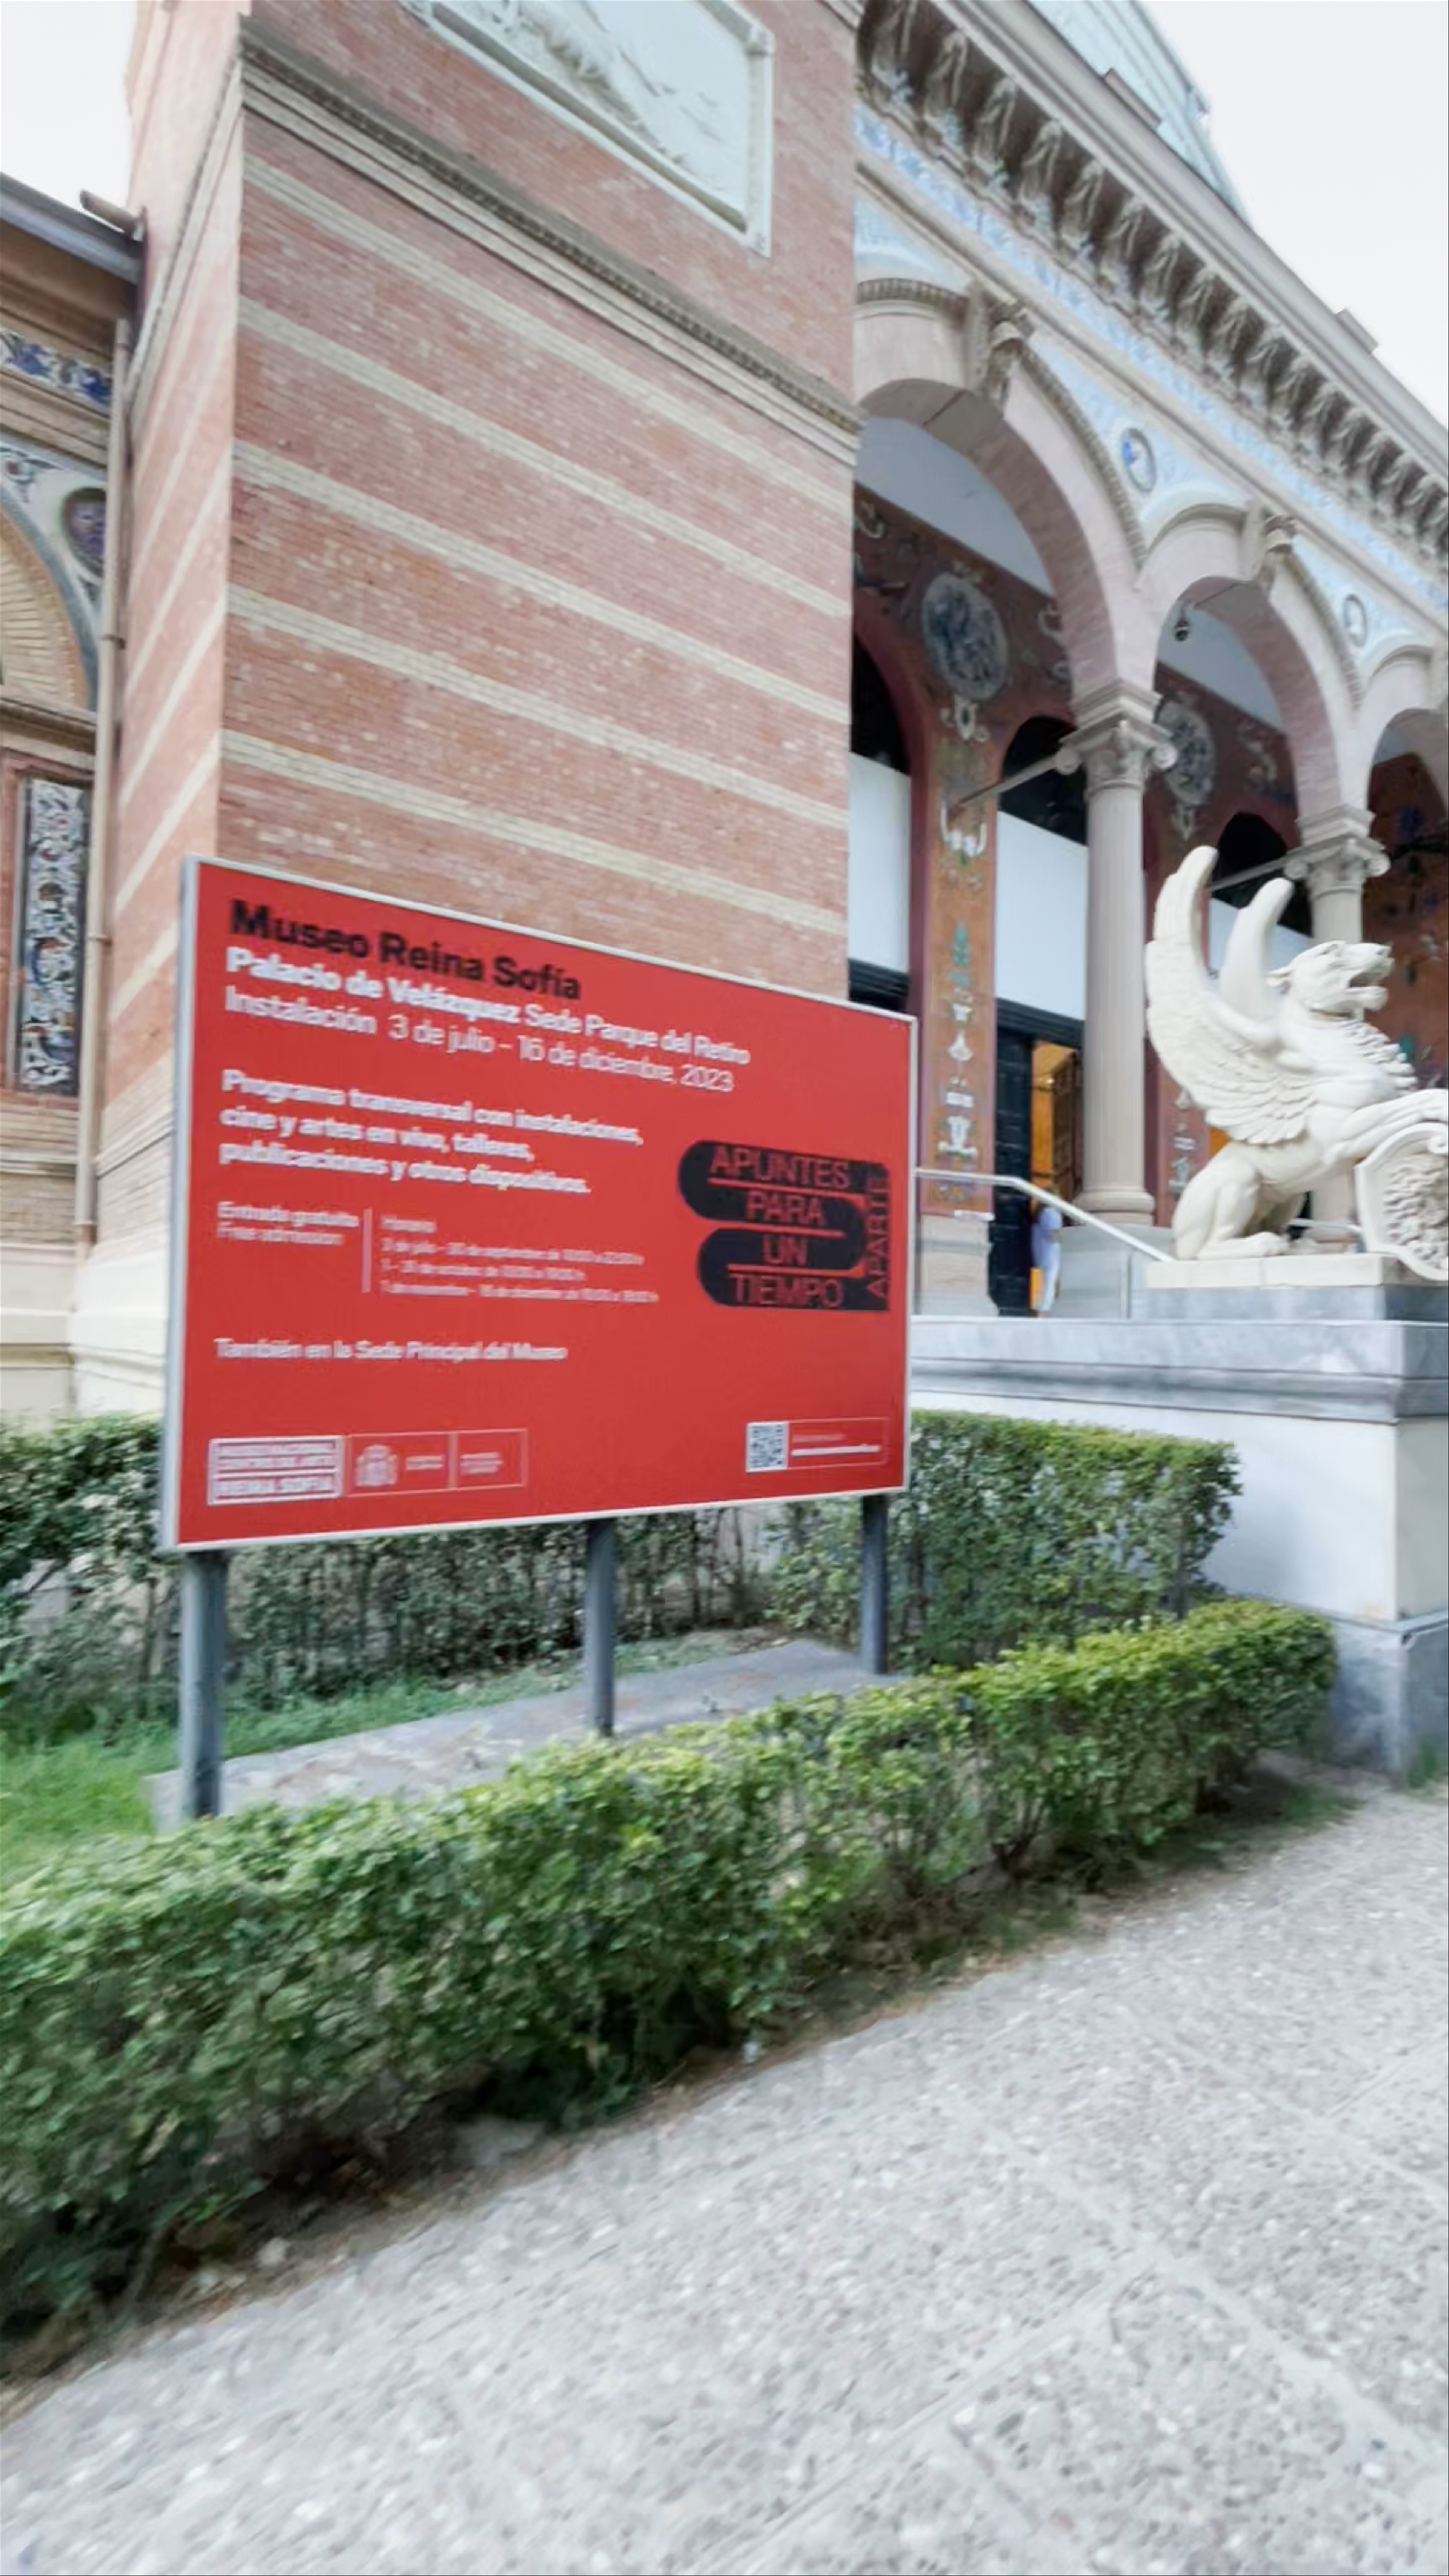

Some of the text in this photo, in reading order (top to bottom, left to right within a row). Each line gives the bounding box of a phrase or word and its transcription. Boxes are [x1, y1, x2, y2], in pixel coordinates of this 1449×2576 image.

[231, 899, 580, 1000] Museo Reina Sofía
[226, 946, 340, 990] Palacio
[345, 970, 382, 998] de
[386, 977, 520, 1023] Velázquez
[525, 1004, 581, 1033] Sede
[585, 1014, 658, 1049] Parque
[660, 1029, 691, 1054] del
[225, 985, 375, 1034] Instalación
[388, 1014, 408, 1040] 3
[412, 1020, 445, 1044] de
[446, 1025, 495, 1054] julio
[518, 1035, 545, 1061] 16
[547, 1041, 576, 1066] de
[680, 1064, 734, 1092] 2023
[222, 1069, 345, 1103] Programa
[220, 1105, 277, 1129] cine
[279, 1117, 297, 1137] y
[710, 1145, 850, 1190] APUNTES
[746, 1190, 825, 1226] PARA
[762, 1234, 808, 1267] UN
[728, 1274, 845, 1309] TIEMPO
